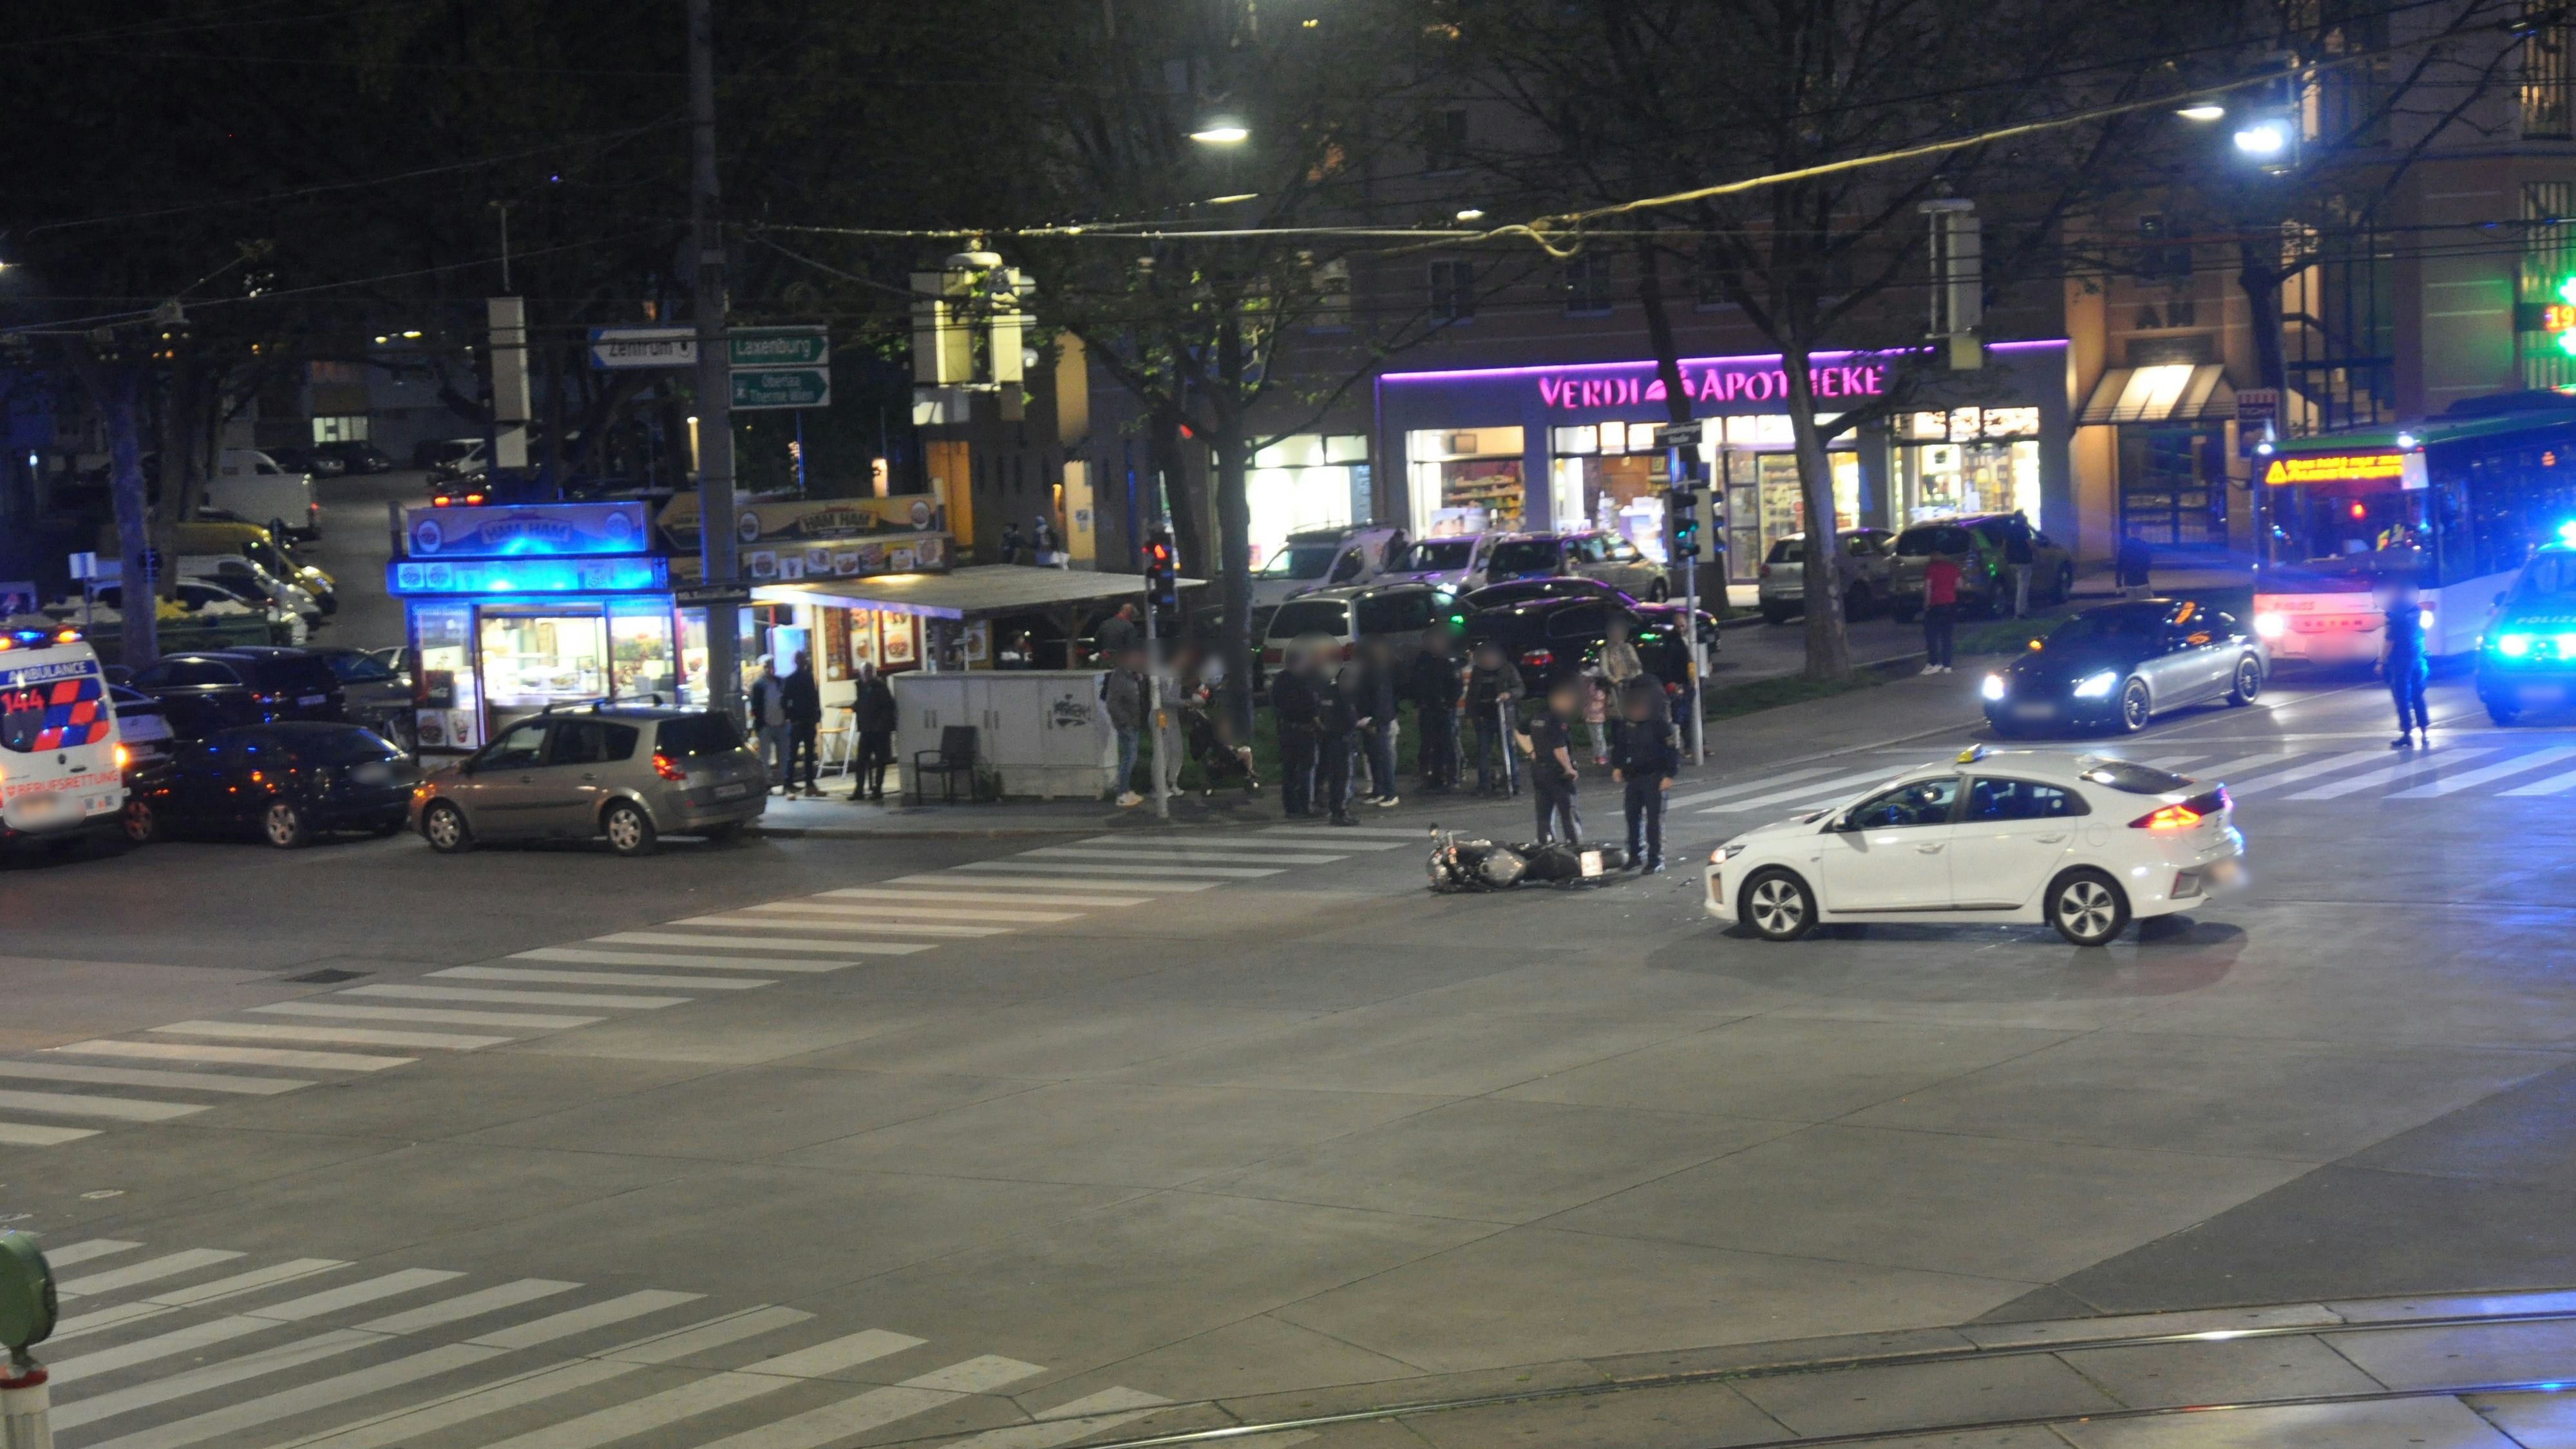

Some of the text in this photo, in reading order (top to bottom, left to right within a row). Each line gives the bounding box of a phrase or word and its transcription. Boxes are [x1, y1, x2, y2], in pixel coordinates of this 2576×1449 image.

[609, 342, 674, 357] Zentrum
[735, 337, 811, 357] Laxenburg
[1538, 377, 1638, 409] VERDI
[8, 661, 88, 684] AMBULANCE
[1, 688, 45, 714] 144
[17, 770, 119, 795] BERUFSRETTUNG
